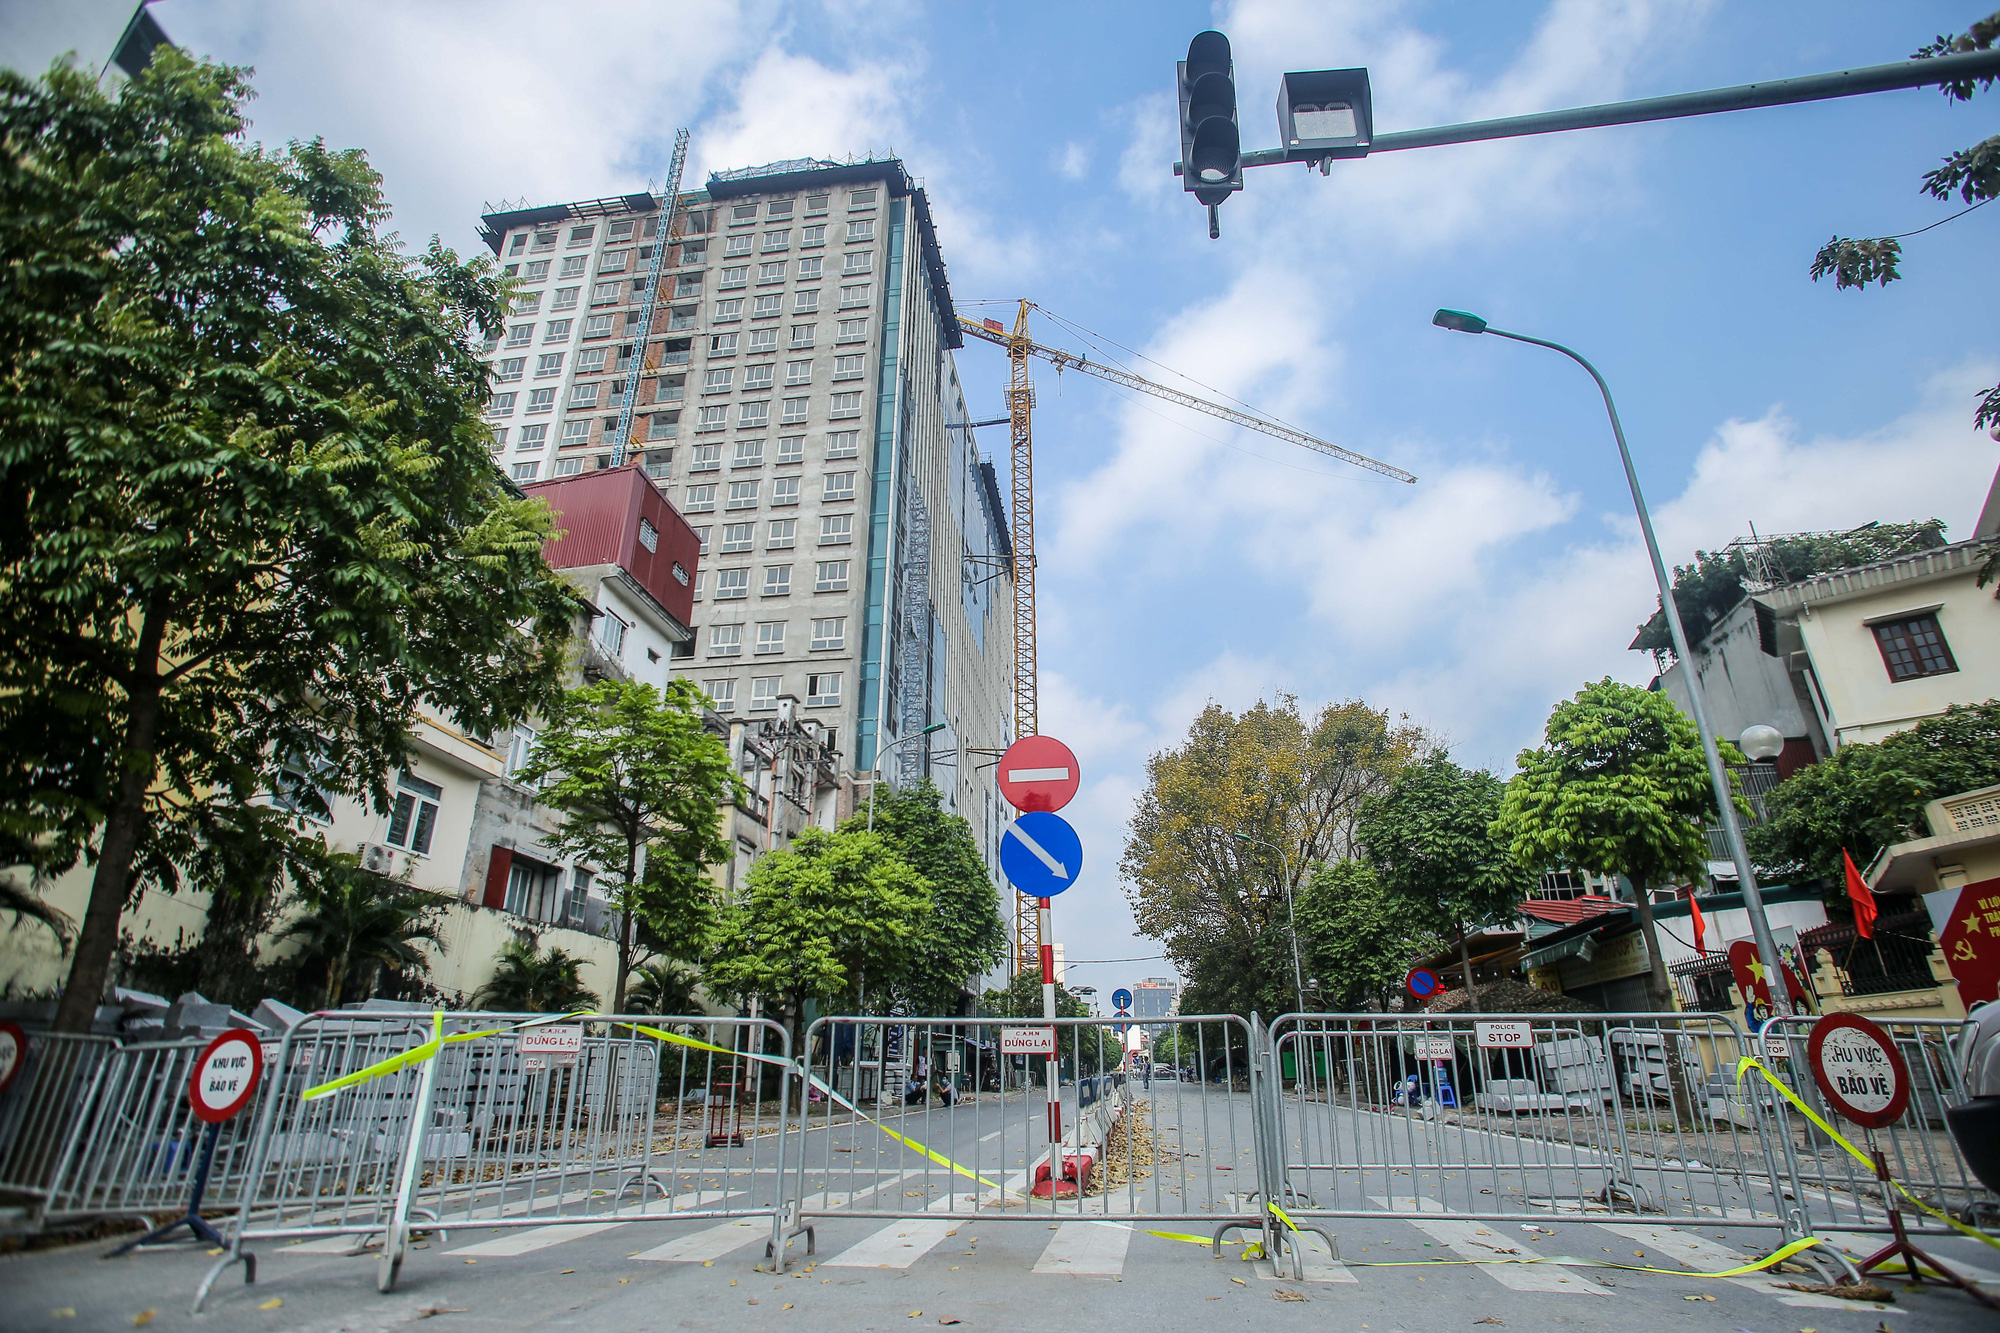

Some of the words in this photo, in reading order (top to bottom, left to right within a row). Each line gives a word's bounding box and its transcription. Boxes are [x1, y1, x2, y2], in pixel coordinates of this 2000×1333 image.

[525, 1034, 557, 1046] DỪNG
[1004, 1036, 1033, 1047] DỪNG
[1034, 1039, 1051, 1049] LẠI
[1488, 1033, 1521, 1043] STOP
[212, 1056, 230, 1070] KHU
[209, 1076, 226, 1093] BẢO
[228, 1076, 239, 1094] VỆ
[1836, 1069, 1868, 1095] BẢO
[1869, 1072, 1891, 1100] VỆ
